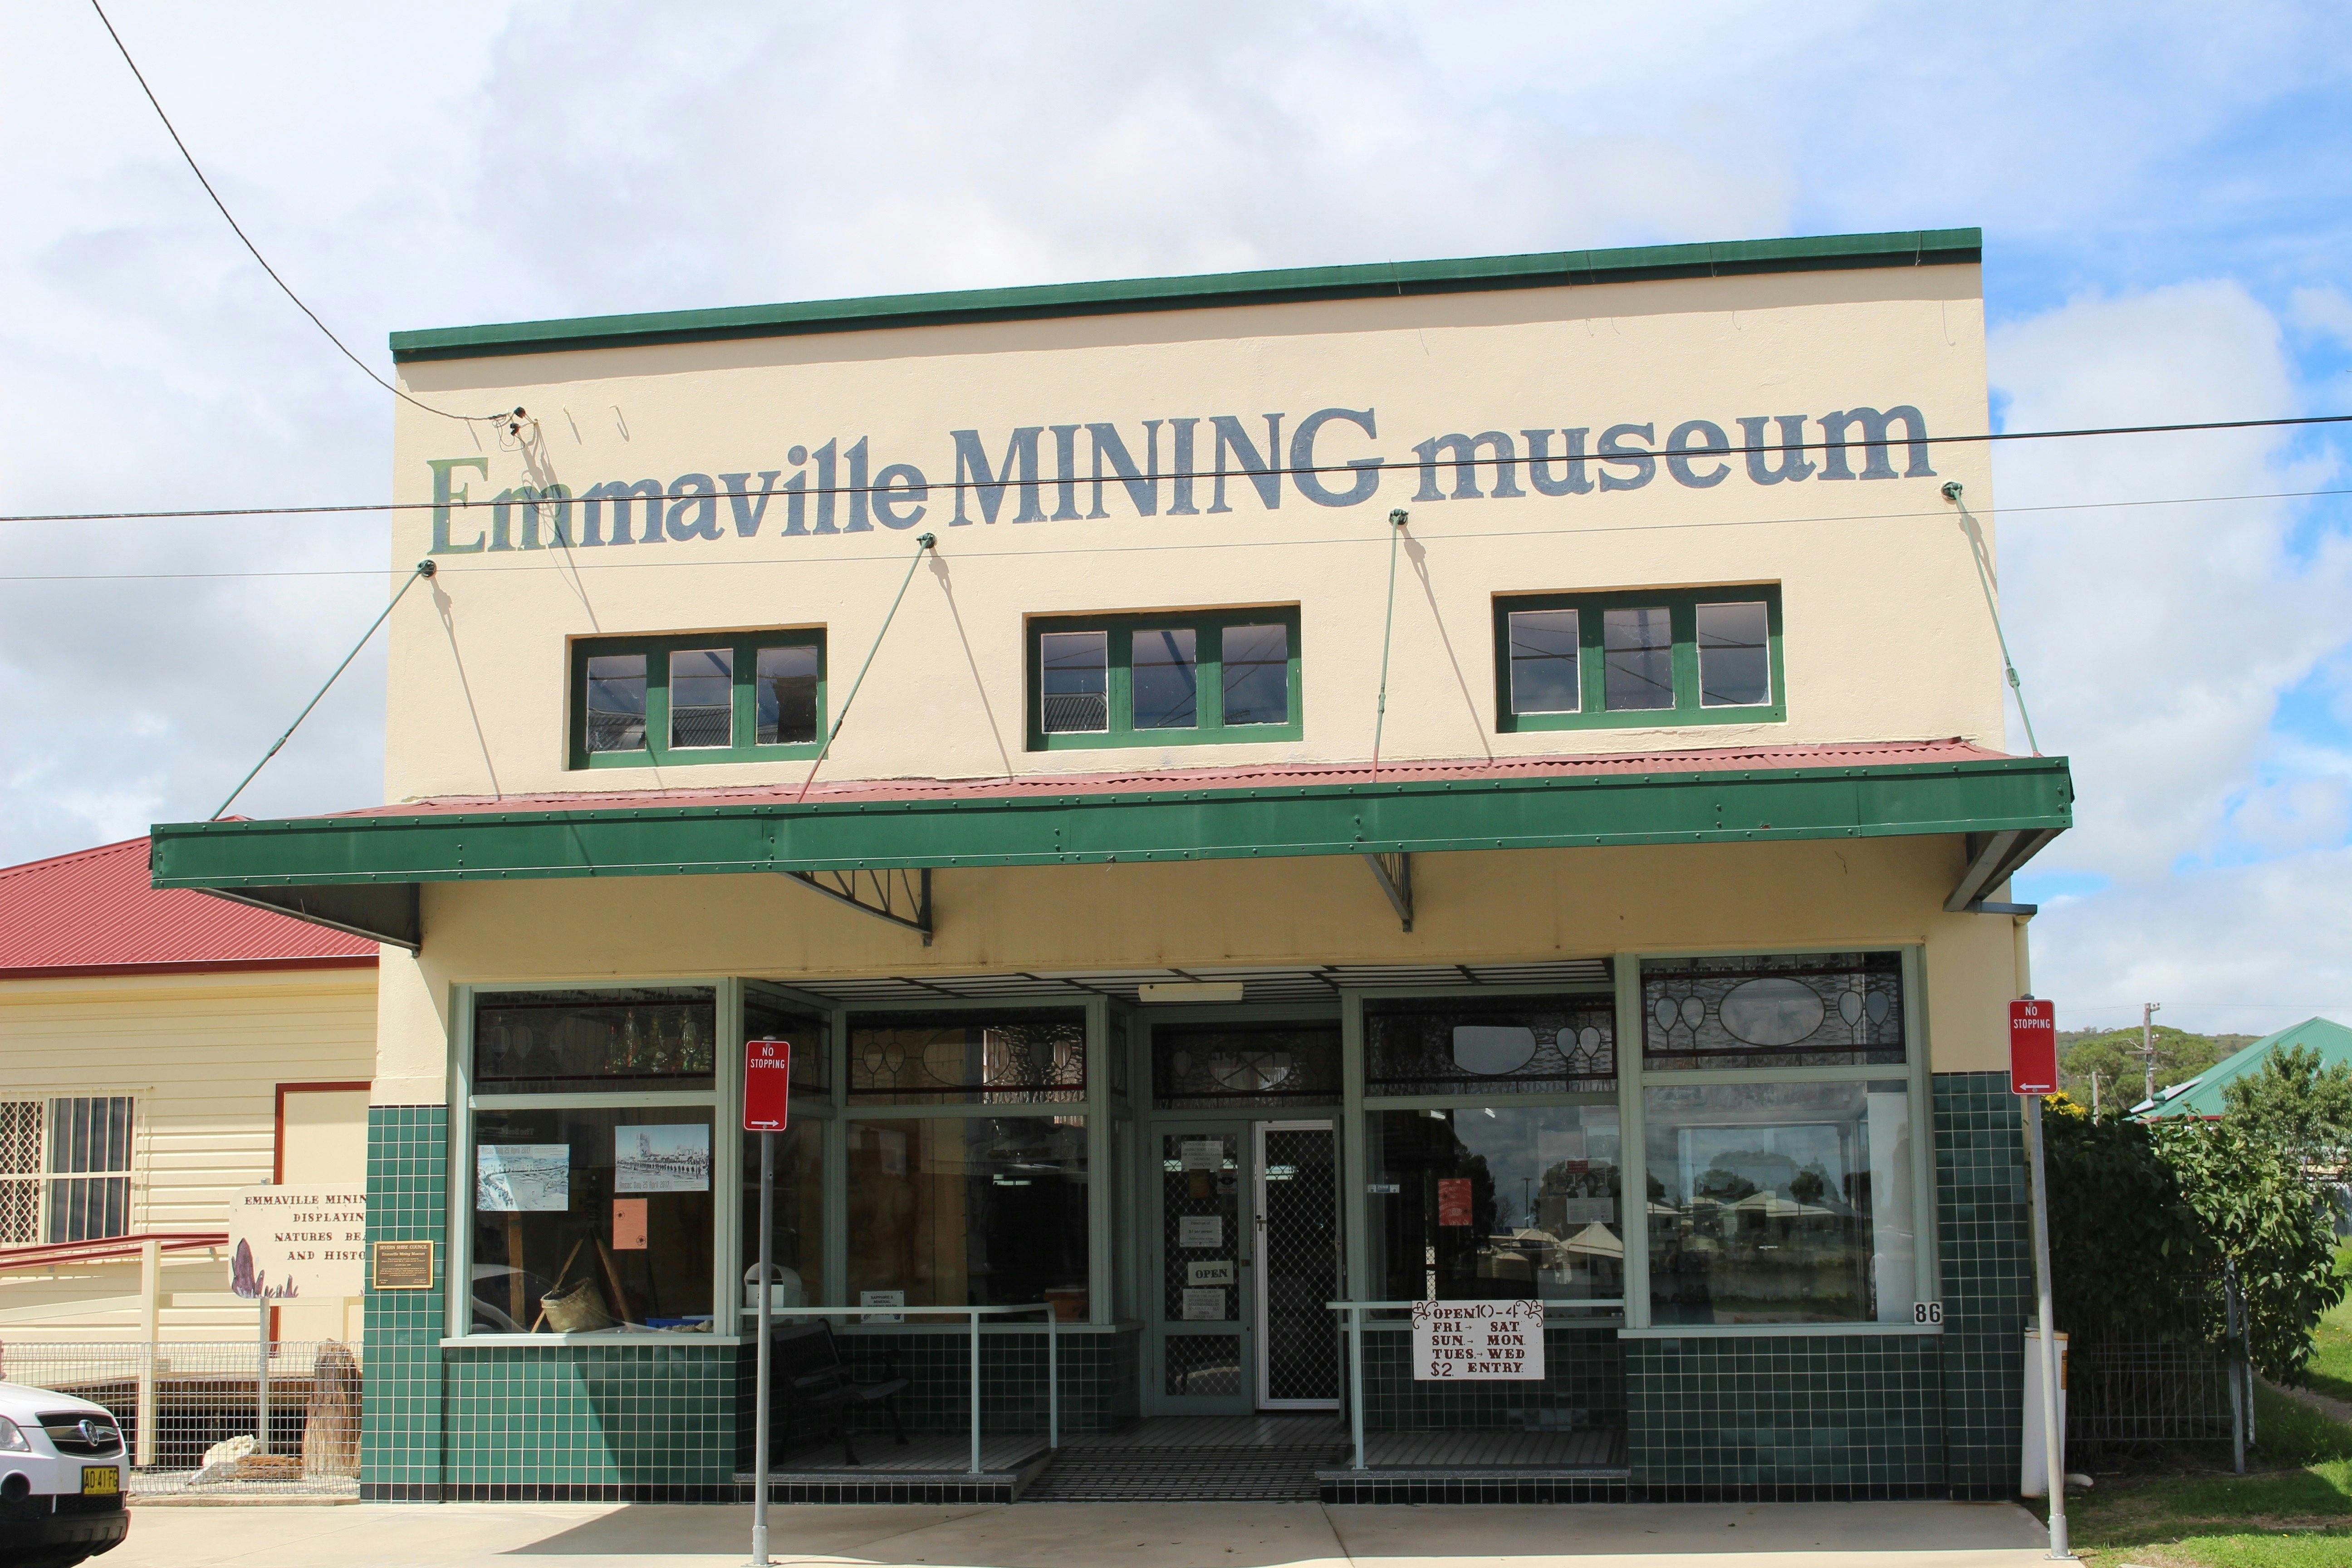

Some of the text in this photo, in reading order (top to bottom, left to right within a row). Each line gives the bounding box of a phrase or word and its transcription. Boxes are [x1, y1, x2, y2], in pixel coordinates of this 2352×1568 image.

[426, 404, 1937, 555] Emmaville MINING museum
[2025, 1006, 2038, 1016] NO
[2014, 1019, 2050, 1029] STOPPING
[762, 1047, 774, 1056] NO
[750, 1058, 785, 1068] STOPPING
[244, 1195, 319, 1205] EMMAVILLE
[293, 1212, 364, 1222] DISPLAYIN
[274, 1232, 333, 1242] NATURES
[287, 1251, 365, 1260] AND HISTO
[1196, 1269, 1228, 1279] OPEN
[1916, 1303, 1940, 1323] 86
